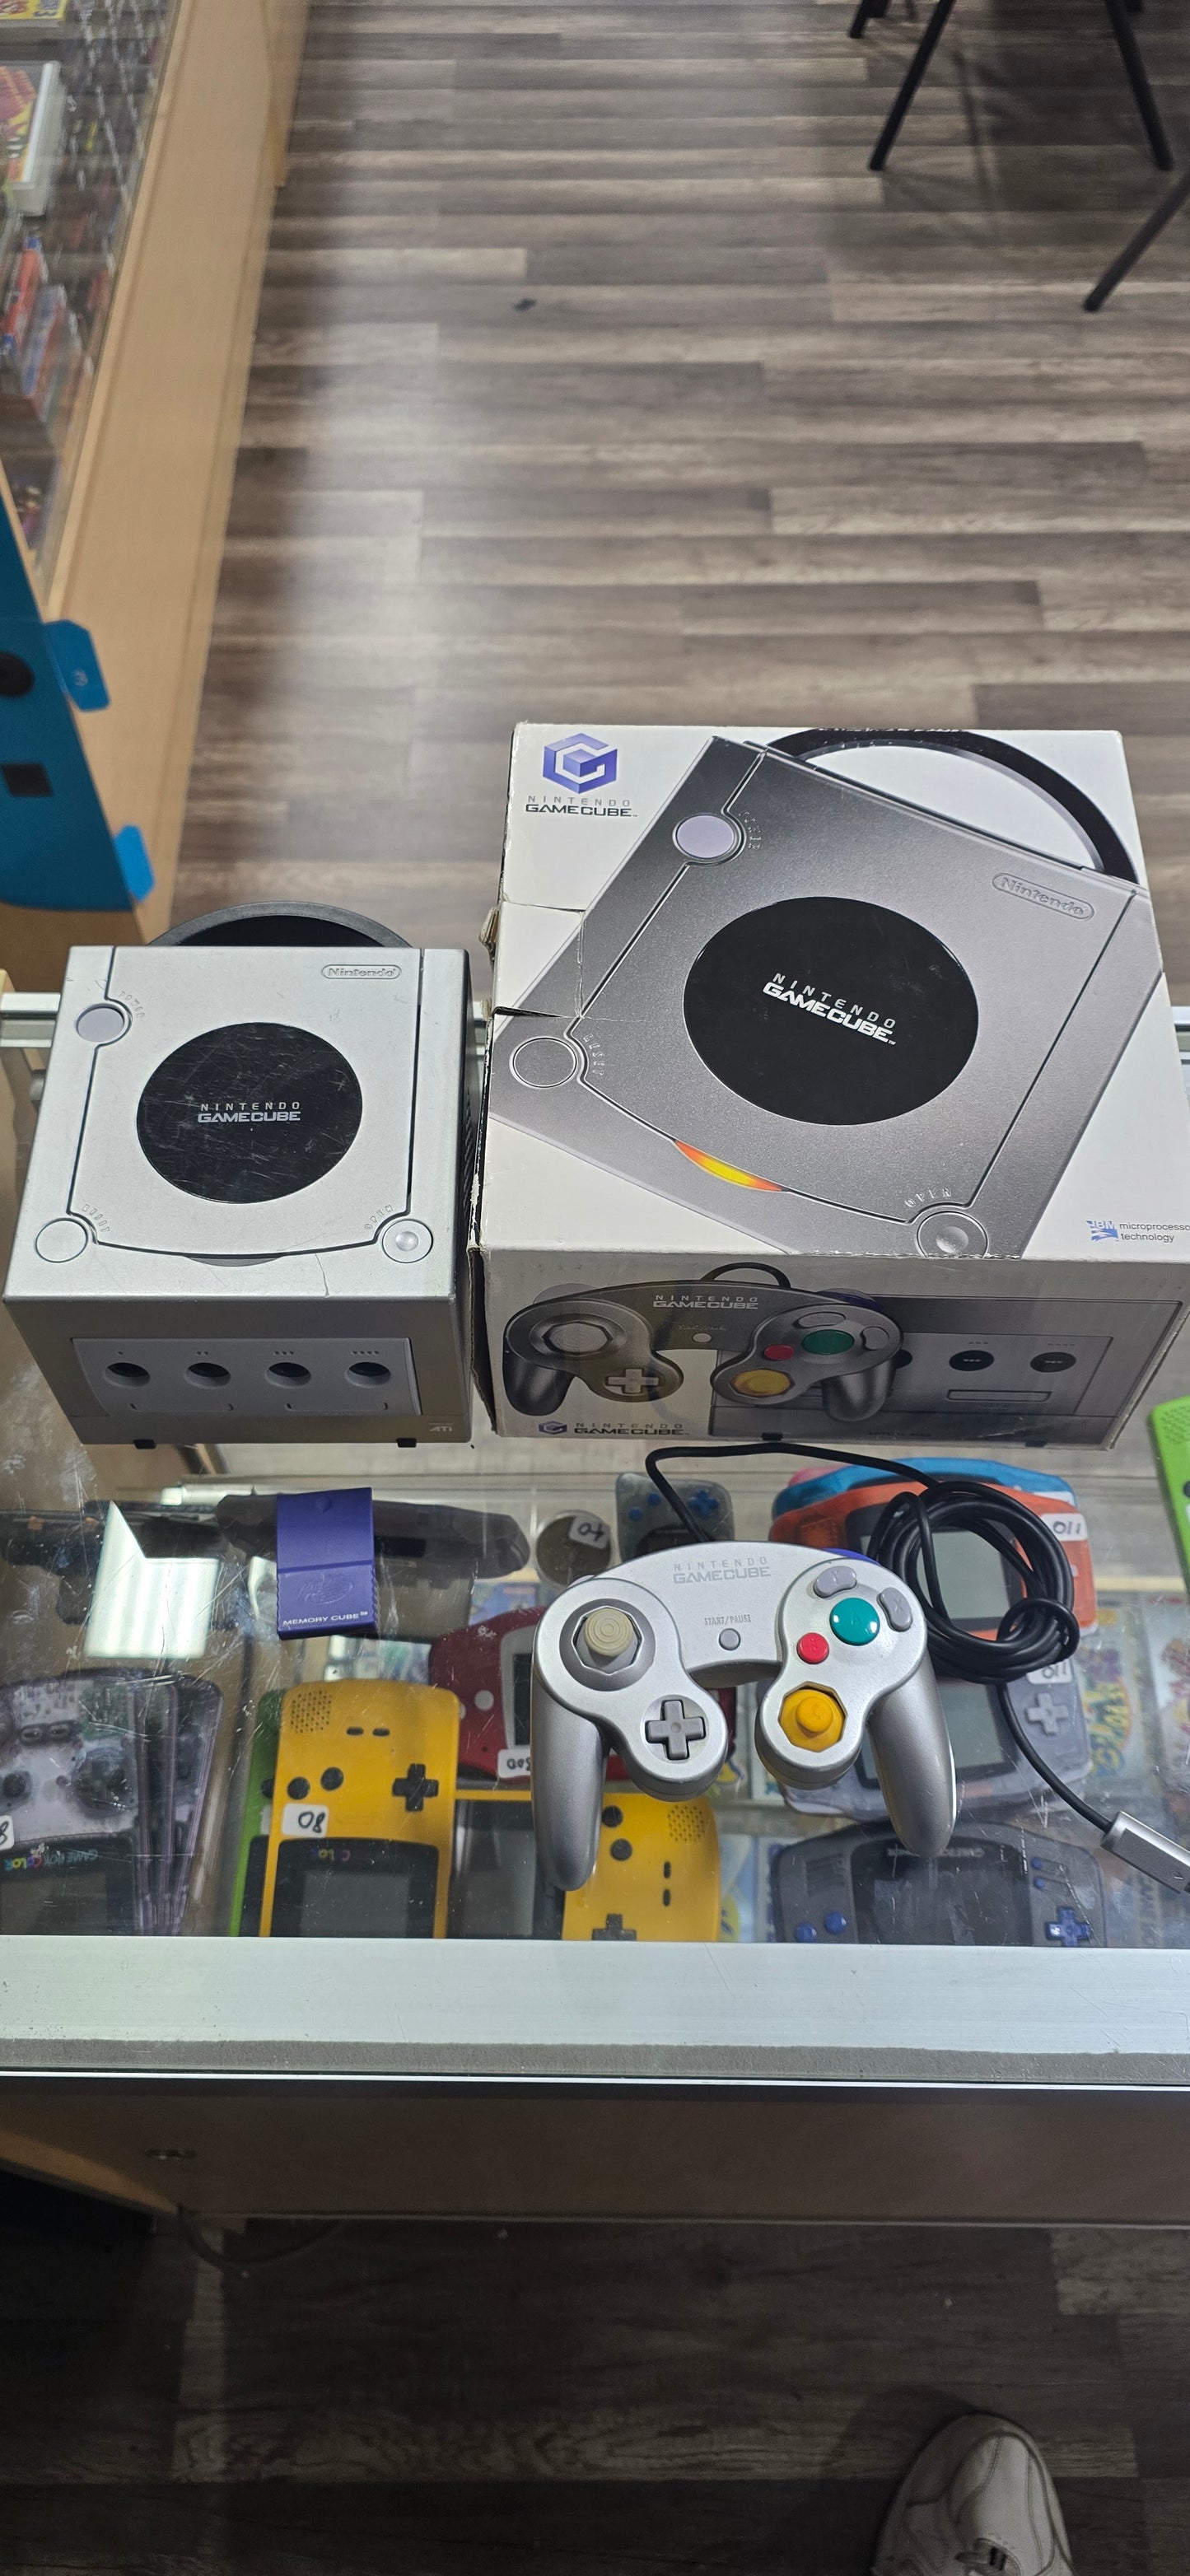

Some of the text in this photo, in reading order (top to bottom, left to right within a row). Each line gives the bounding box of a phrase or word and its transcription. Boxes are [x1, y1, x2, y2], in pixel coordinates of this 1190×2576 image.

[528, 796, 630, 807] NINTENDO
[525, 804, 632, 817] GAMECUBE
[1001, 877, 1084, 916] Nintendo
[328, 968, 395, 977] Nintendo
[772, 973, 896, 1029] NINTENDO
[201, 1101, 300, 1112] NINTENDO
[198, 1111, 301, 1122] GAMECUBE
[1121, 1233, 1174, 1243] technology
[653, 1300, 758, 1309] GAMECUBE
[574, 1427, 685, 1435] GAMECUBE
[674, 1556, 768, 1572] NINTENDO
[673, 1566, 772, 1584] GAMECUBE
[282, 1616, 329, 1626] MEMORY
[704, 1614, 752, 1626] START/PAUSE
